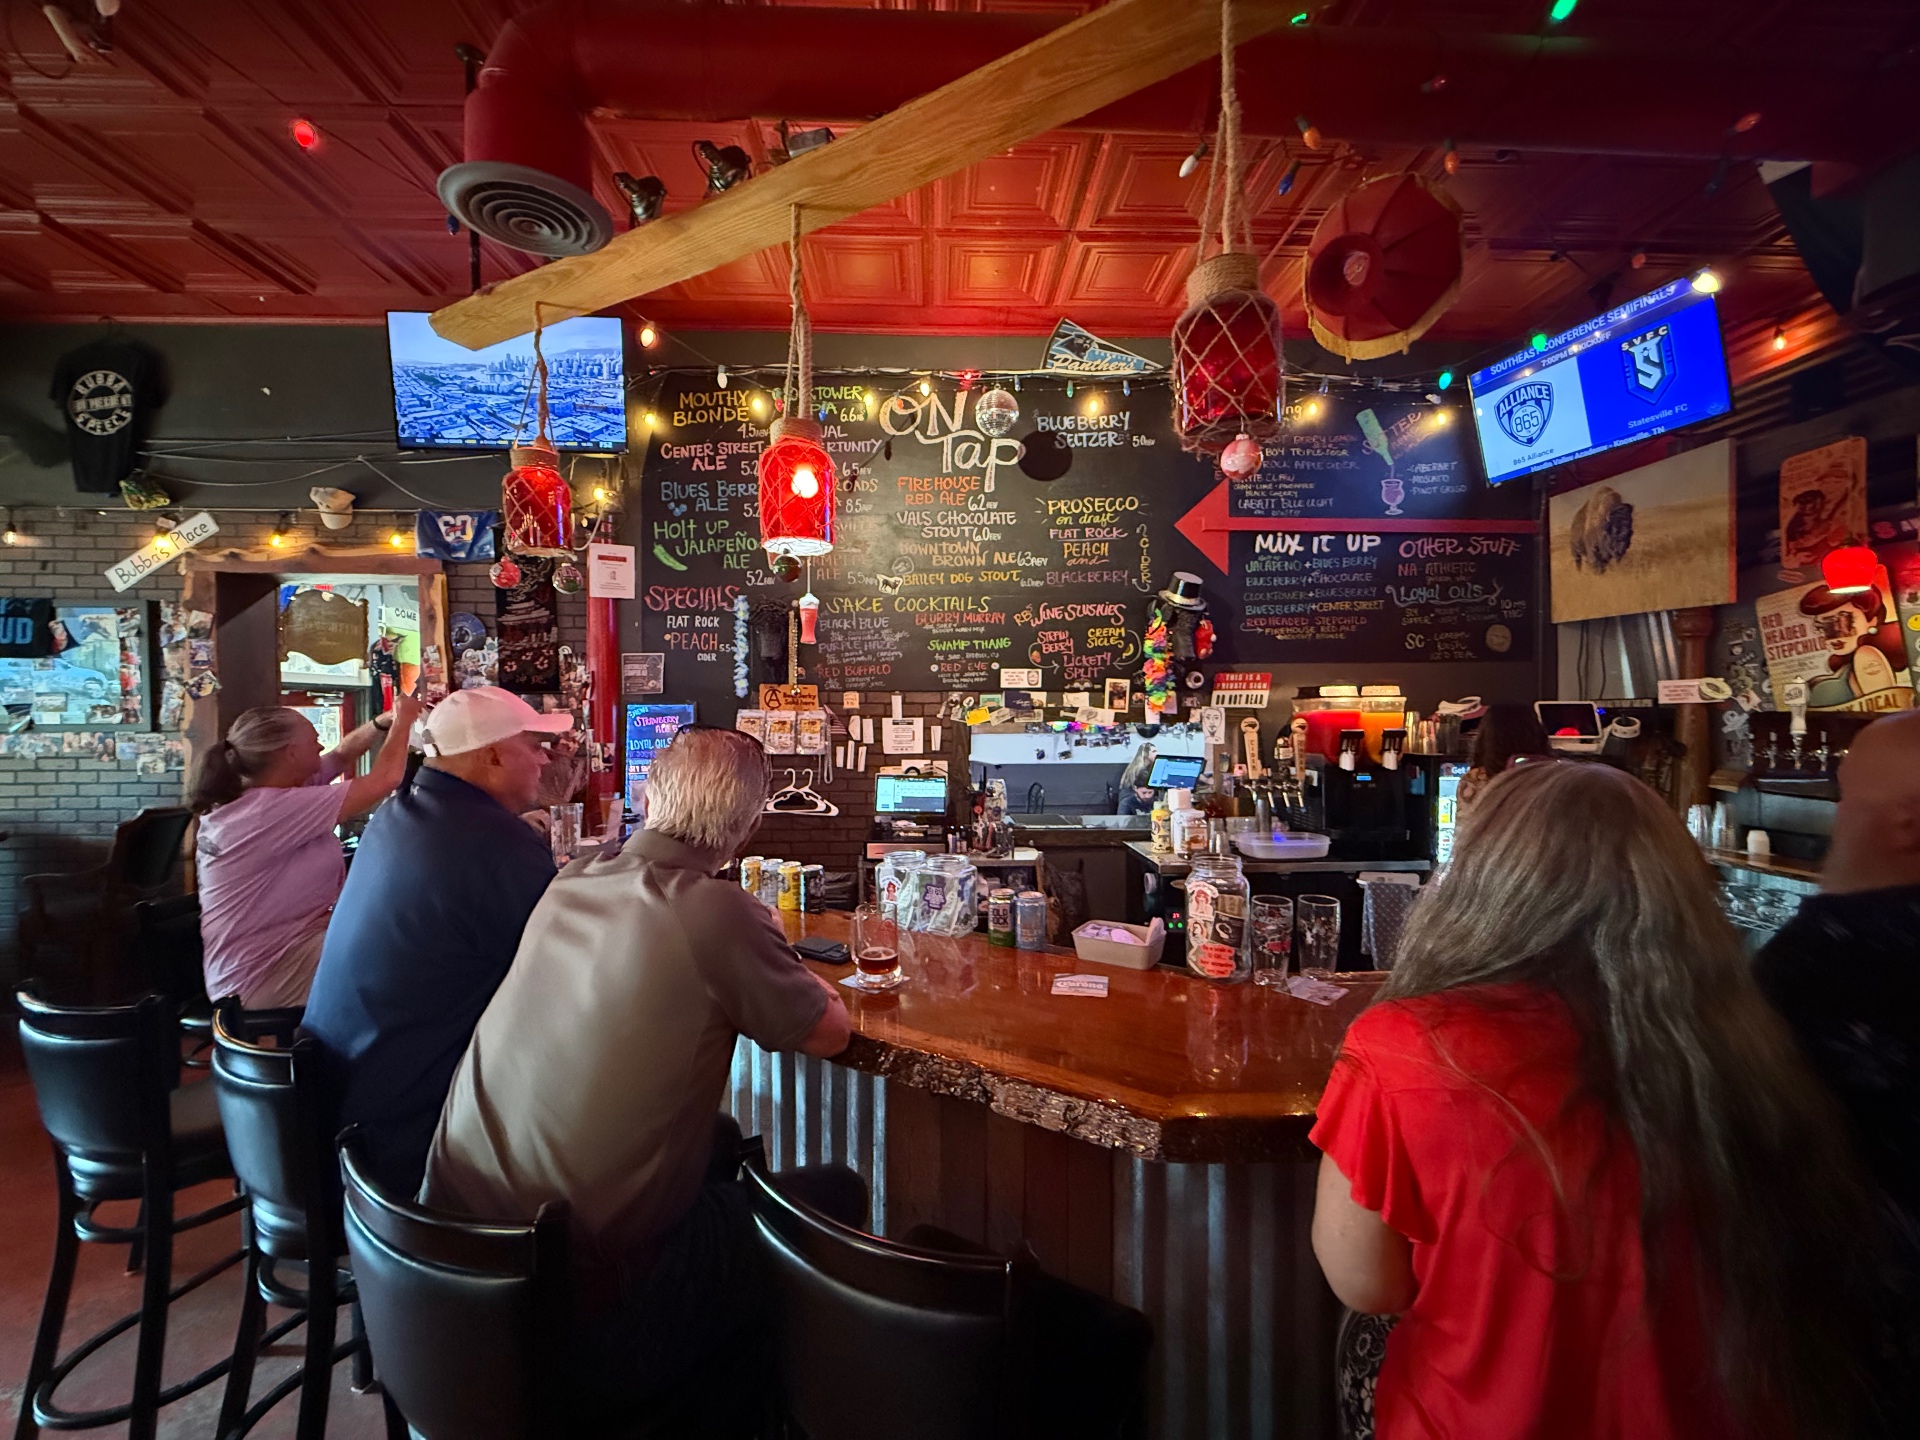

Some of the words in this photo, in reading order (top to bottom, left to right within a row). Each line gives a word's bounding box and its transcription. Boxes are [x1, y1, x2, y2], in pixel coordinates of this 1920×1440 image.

[1490, 348, 1543, 375] SOUTHEAST
[1542, 318, 1606, 353] CONFERENCE
[1607, 284, 1677, 323] SEMIFINALS
[1053, 353, 1136, 371] Panthers
[680, 390, 749, 409] MOUTHY
[1499, 385, 1551, 417] ALLIANCE
[673, 407, 749, 427] BLONDE
[879, 390, 969, 436] ON
[1514, 410, 1540, 433] 865
[1628, 408, 1673, 430] Statesville
[1675, 404, 1689, 416] FC
[1037, 411, 1130, 433] BLUEBERRY
[1054, 431, 1123, 449] SELTZER
[661, 443, 714, 459] CENTER
[717, 440, 765, 455] STREET
[1513, 456, 1526, 466] 865
[1527, 449, 1554, 462] Alliance
[691, 455, 727, 471] ALE
[914, 429, 1027, 492] Tap
[717, 480, 760, 497] BERR
[897, 476, 981, 493] FIREHOUSE
[695, 498, 729, 512] ALE
[905, 493, 934, 505] RED
[939, 491, 966, 506] ALE
[1047, 496, 1139, 515] PROSECCO
[896, 511, 931, 526] VALS
[937, 511, 1017, 525] CHOCOLATE
[1056, 514, 1073, 525] on
[1078, 512, 1120, 527] draft
[705, 520, 729, 535] UP
[921, 526, 974, 538] STOUT
[1049, 527, 1079, 539] FLAT
[1085, 526, 1129, 539] ROCK
[675, 530, 758, 557] JALAPEÑO
[1063, 542, 1108, 559] PEACH
[1312, 535, 1336, 554] IT
[1346, 534, 1381, 553] UP
[1398, 537, 1463, 558] OTHER
[1466, 536, 1522, 557] STUFF
[115, 548, 171, 585] Bubba's
[170, 523, 209, 551] Place
[723, 553, 751, 569] ALE
[932, 551, 988, 567] BROWN
[993, 551, 1016, 565] ALE
[1066, 556, 1110, 566] and
[1139, 537, 1152, 584] CIDER
[816, 568, 841, 580] ALE
[903, 573, 945, 586] BAILEY
[950, 573, 974, 584] DOG
[978, 569, 1022, 584] STOUT
[1046, 569, 1129, 586] BLACKBERRY
[644, 585, 741, 613] SPECIALS
[826, 597, 884, 613] SAKE
[894, 596, 992, 614] COCKTAILS
[395, 608, 417, 622] COME
[667, 616, 689, 628] FLAT
[695, 616, 720, 628] ROCK
[915, 613, 960, 625] BLURRY
[963, 612, 1006, 624] MURRAY
[1030, 602, 1064, 627] WINE
[1246, 618, 1267, 627] RED
[1314, 616, 1368, 625] STEPCHILD
[820, 618, 851, 631] BLACK
[859, 617, 890, 630] BLUE
[1088, 627, 1125, 638] CREAM
[670, 633, 718, 650] PEACH
[1037, 630, 1069, 644] STRAW
[1765, 624, 1807, 645] HEADED
[819, 641, 861, 653] PURPLE
[864, 641, 897, 651] HAZE
[927, 640, 970, 650] SWAMP
[973, 638, 1012, 650] THANG
[1042, 638, 1074, 654] BERRY
[1767, 637, 1827, 661] STEPCHILD
[697, 653, 717, 662] CIDER
[1063, 651, 1112, 667] LICKETY
[818, 667, 840, 678] RED
[845, 664, 891, 676] BUFFALO
[940, 663, 961, 672] RED
[968, 662, 988, 671] EYE
[1064, 666, 1106, 680] SPLIT
[1216, 694, 1226, 705] DO
[1229, 694, 1243, 705] NOT
[1245, 694, 1264, 705] READ
[1056, 981, 1104, 989] Corona
